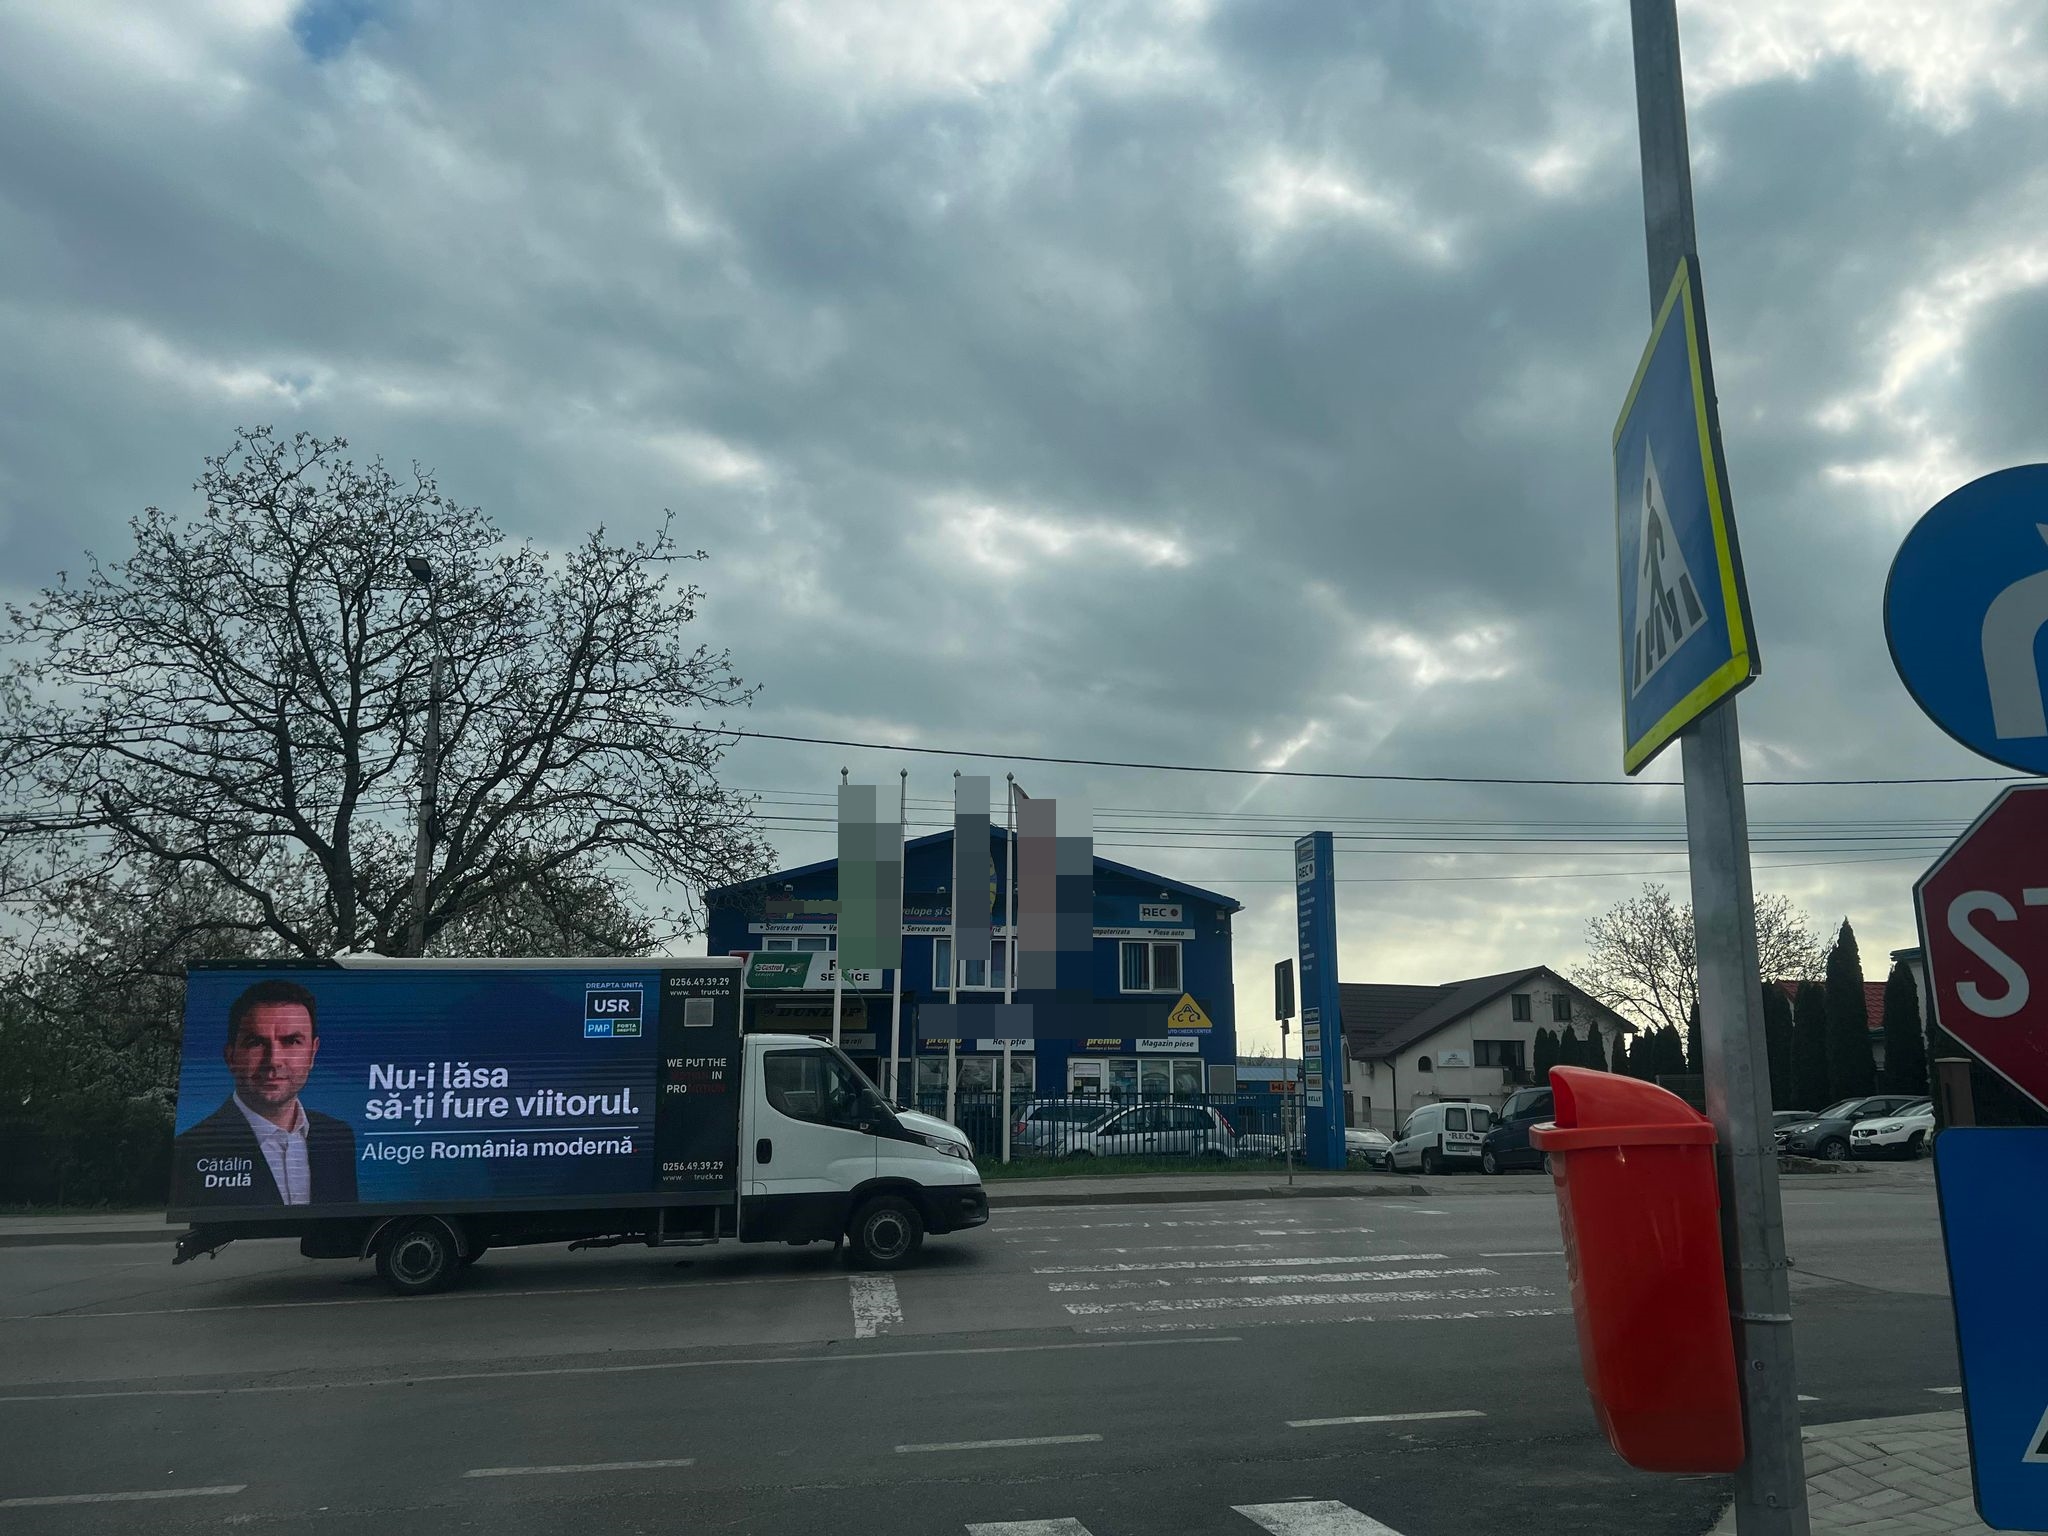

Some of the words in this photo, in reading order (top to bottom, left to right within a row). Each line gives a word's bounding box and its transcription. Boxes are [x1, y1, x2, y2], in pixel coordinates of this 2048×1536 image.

[1143, 908, 1167, 917] REC
[821, 973, 870, 981] SEICE
[670, 978, 730, 986] 0256.49.39.29
[588, 1024, 610, 1033] PMP
[1141, 1039, 1173, 1048] Magazin
[1174, 1040, 1194, 1048] piese
[667, 1059, 683, 1067] WE
[685, 1058, 706, 1067] PUT
[707, 1058, 727, 1067] THE
[368, 1063, 435, 1090] Nu-i
[443, 1061, 509, 1089] lăsa
[711, 1071, 722, 1080] IN
[365, 1092, 434, 1126] să-ți
[442, 1090, 509, 1118] fure
[515, 1087, 640, 1117] viitorul.
[361, 1141, 425, 1165] Alege
[429, 1139, 529, 1159] România
[196, 1156, 253, 1172] Cătălin
[662, 1161, 724, 1171] 0256.49.39.29
[204, 1173, 252, 1188] Drulă
